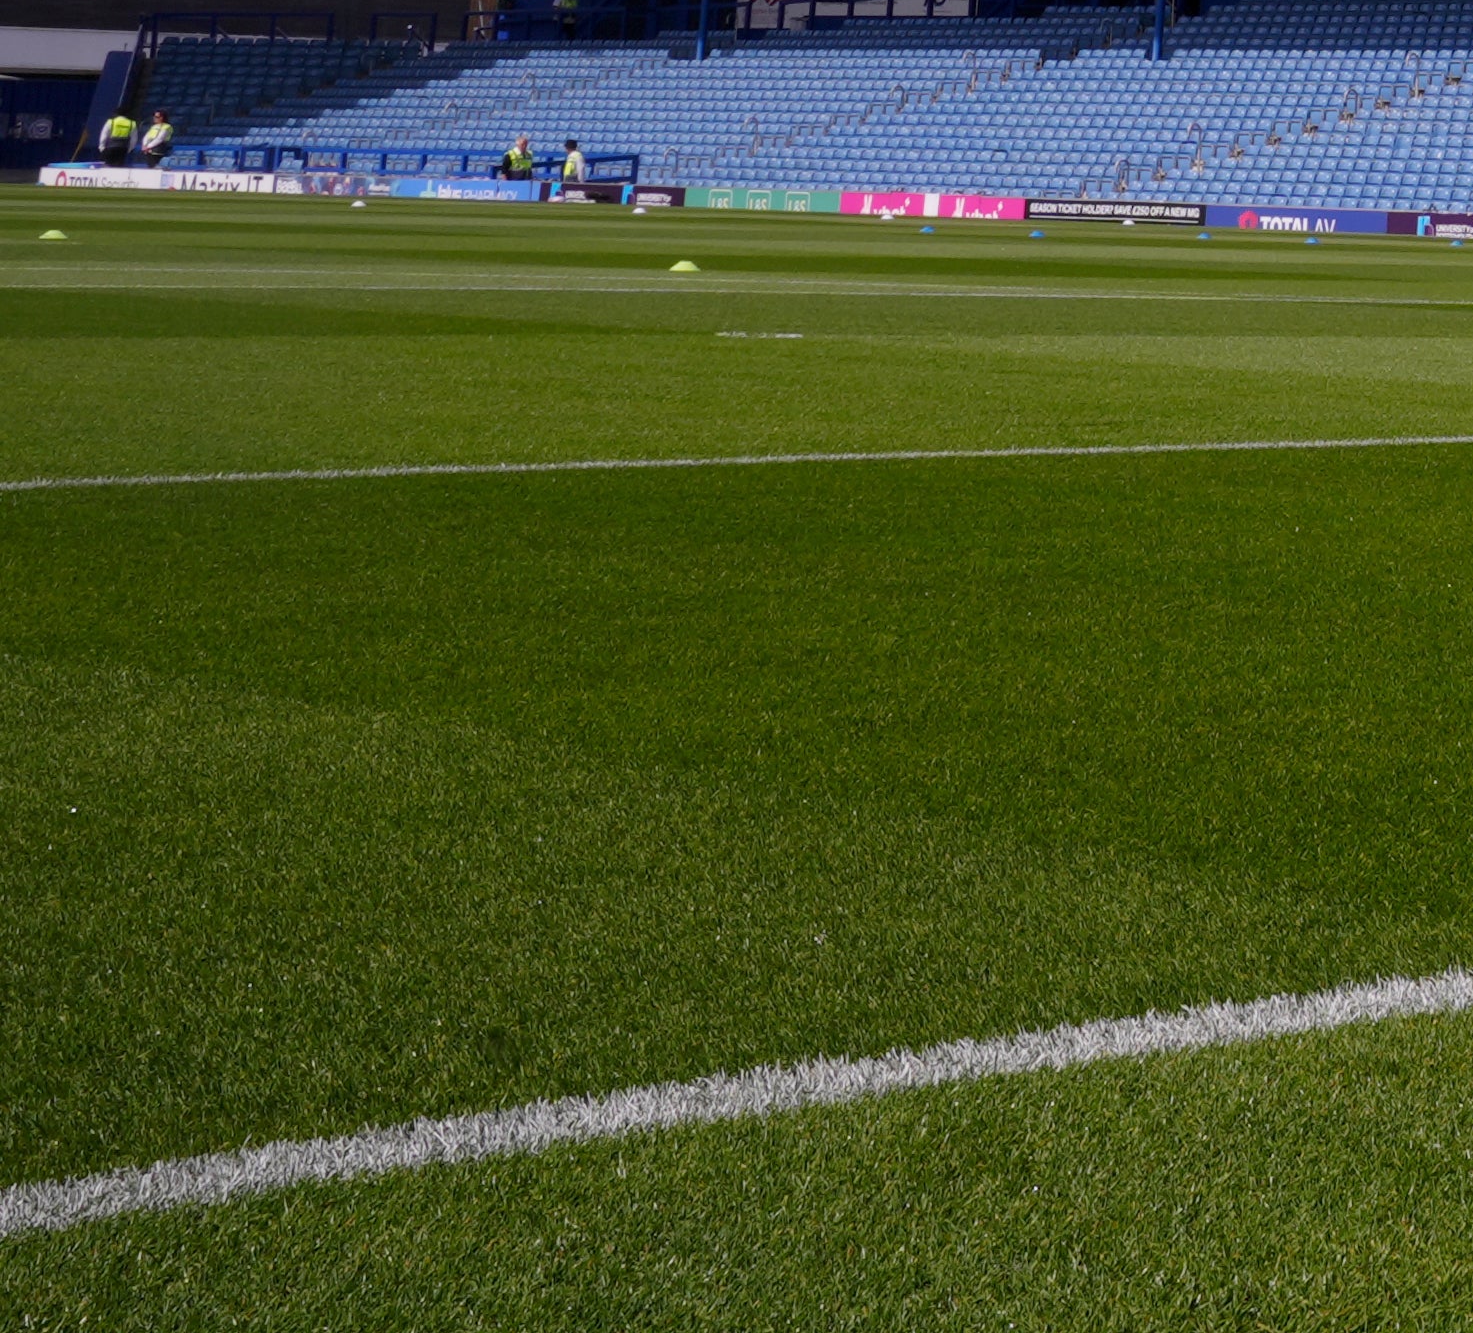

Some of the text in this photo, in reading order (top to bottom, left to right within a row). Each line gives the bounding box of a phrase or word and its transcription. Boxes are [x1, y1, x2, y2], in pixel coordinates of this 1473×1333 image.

[1029, 202, 1058, 214] SEASON
[1058, 203, 1082, 214] TICKET
[1114, 205, 1131, 216] SAVE
[1150, 206, 1163, 217] OFF
[1163, 206, 1170, 217] A
[1170, 206, 1187, 218] NEW
